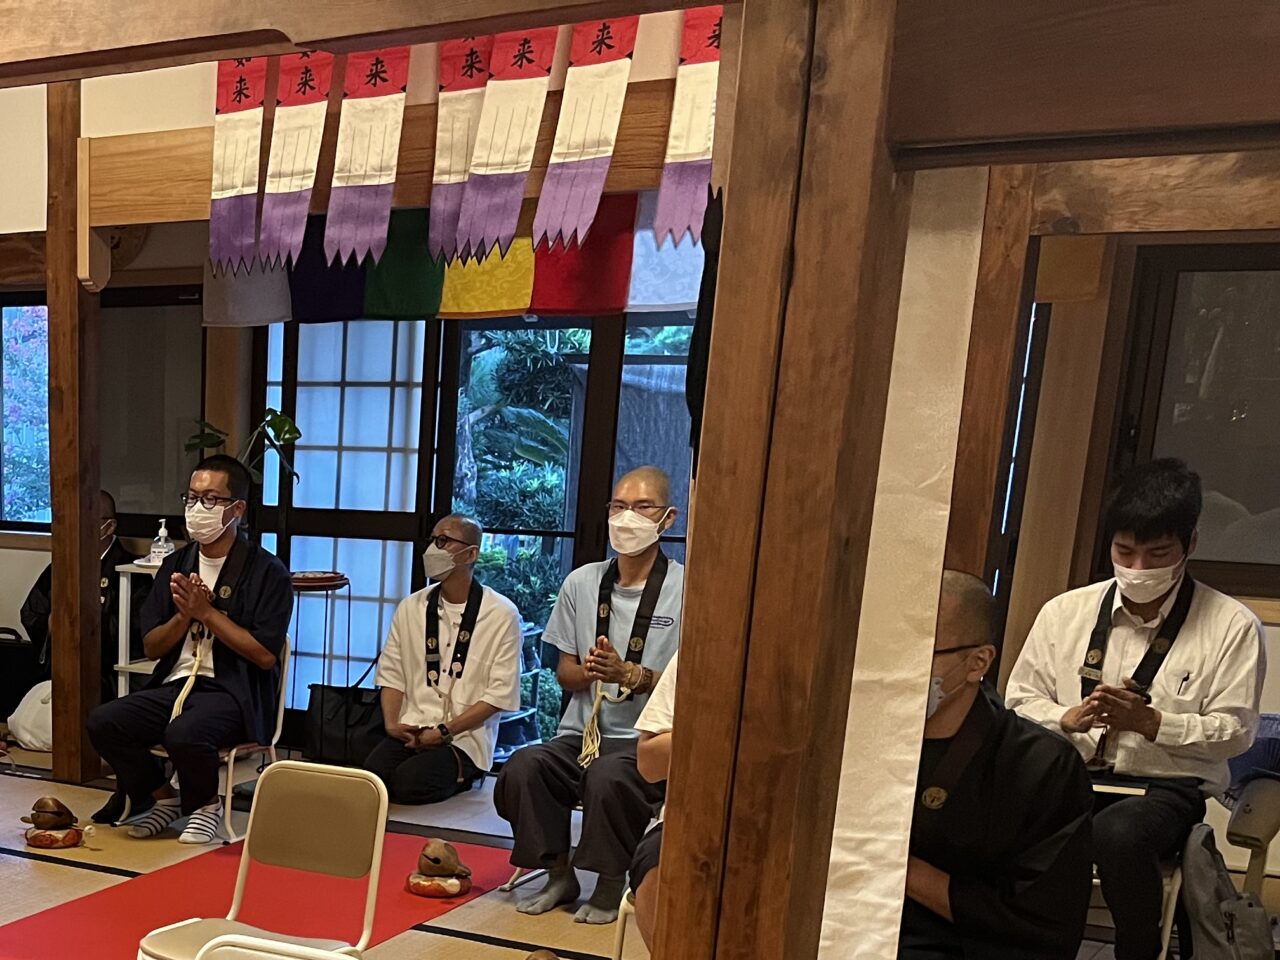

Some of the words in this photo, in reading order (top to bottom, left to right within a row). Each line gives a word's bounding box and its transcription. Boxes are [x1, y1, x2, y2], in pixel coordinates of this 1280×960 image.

[511, 37, 536, 70] 来
[590, 22, 615, 56] 来
[365, 56, 389, 88] 来
[461, 36, 485, 80] 来
